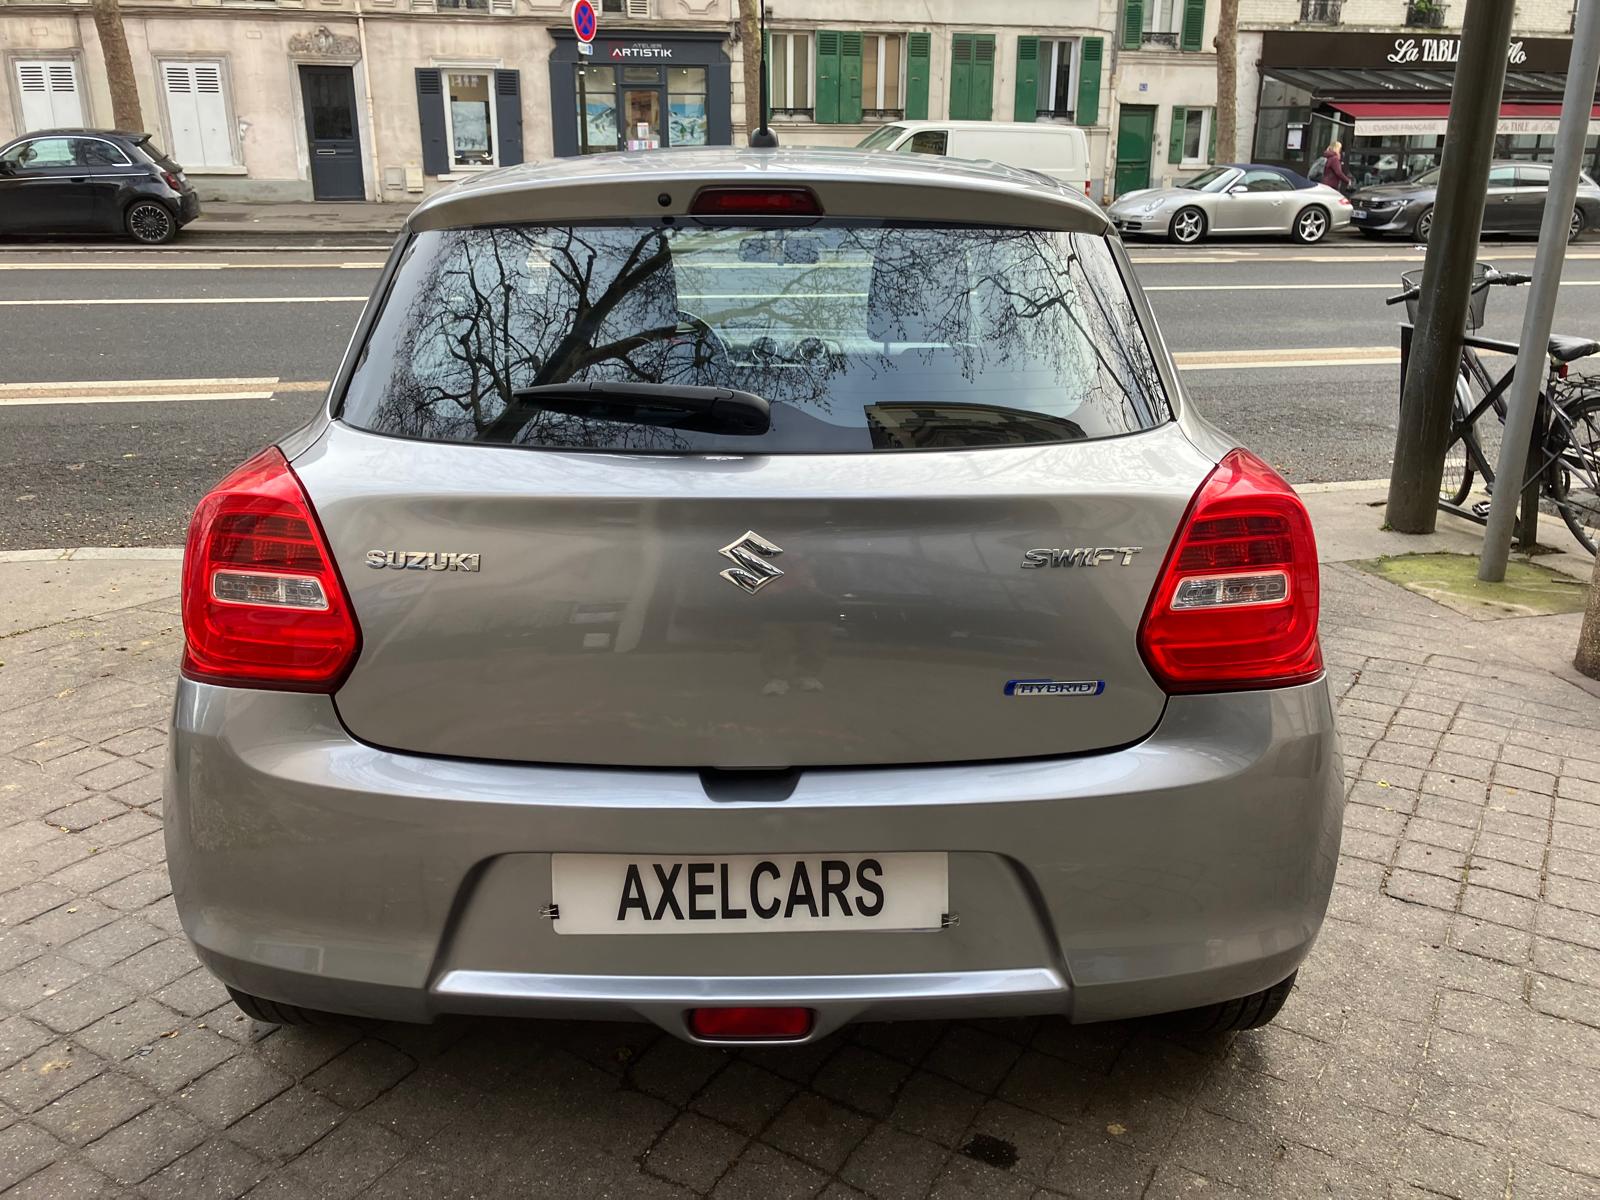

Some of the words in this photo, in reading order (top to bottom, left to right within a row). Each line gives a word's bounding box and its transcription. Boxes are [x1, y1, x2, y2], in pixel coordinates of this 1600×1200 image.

[612, 48, 672, 57] ARTISTIK
[1387, 38, 1419, 63] La
[365, 549, 481, 572] SUZUKI
[1020, 546, 1143, 569] SWIFT
[1020, 683, 1092, 693] HYBRID
[617, 858, 884, 921] AXELCARS
